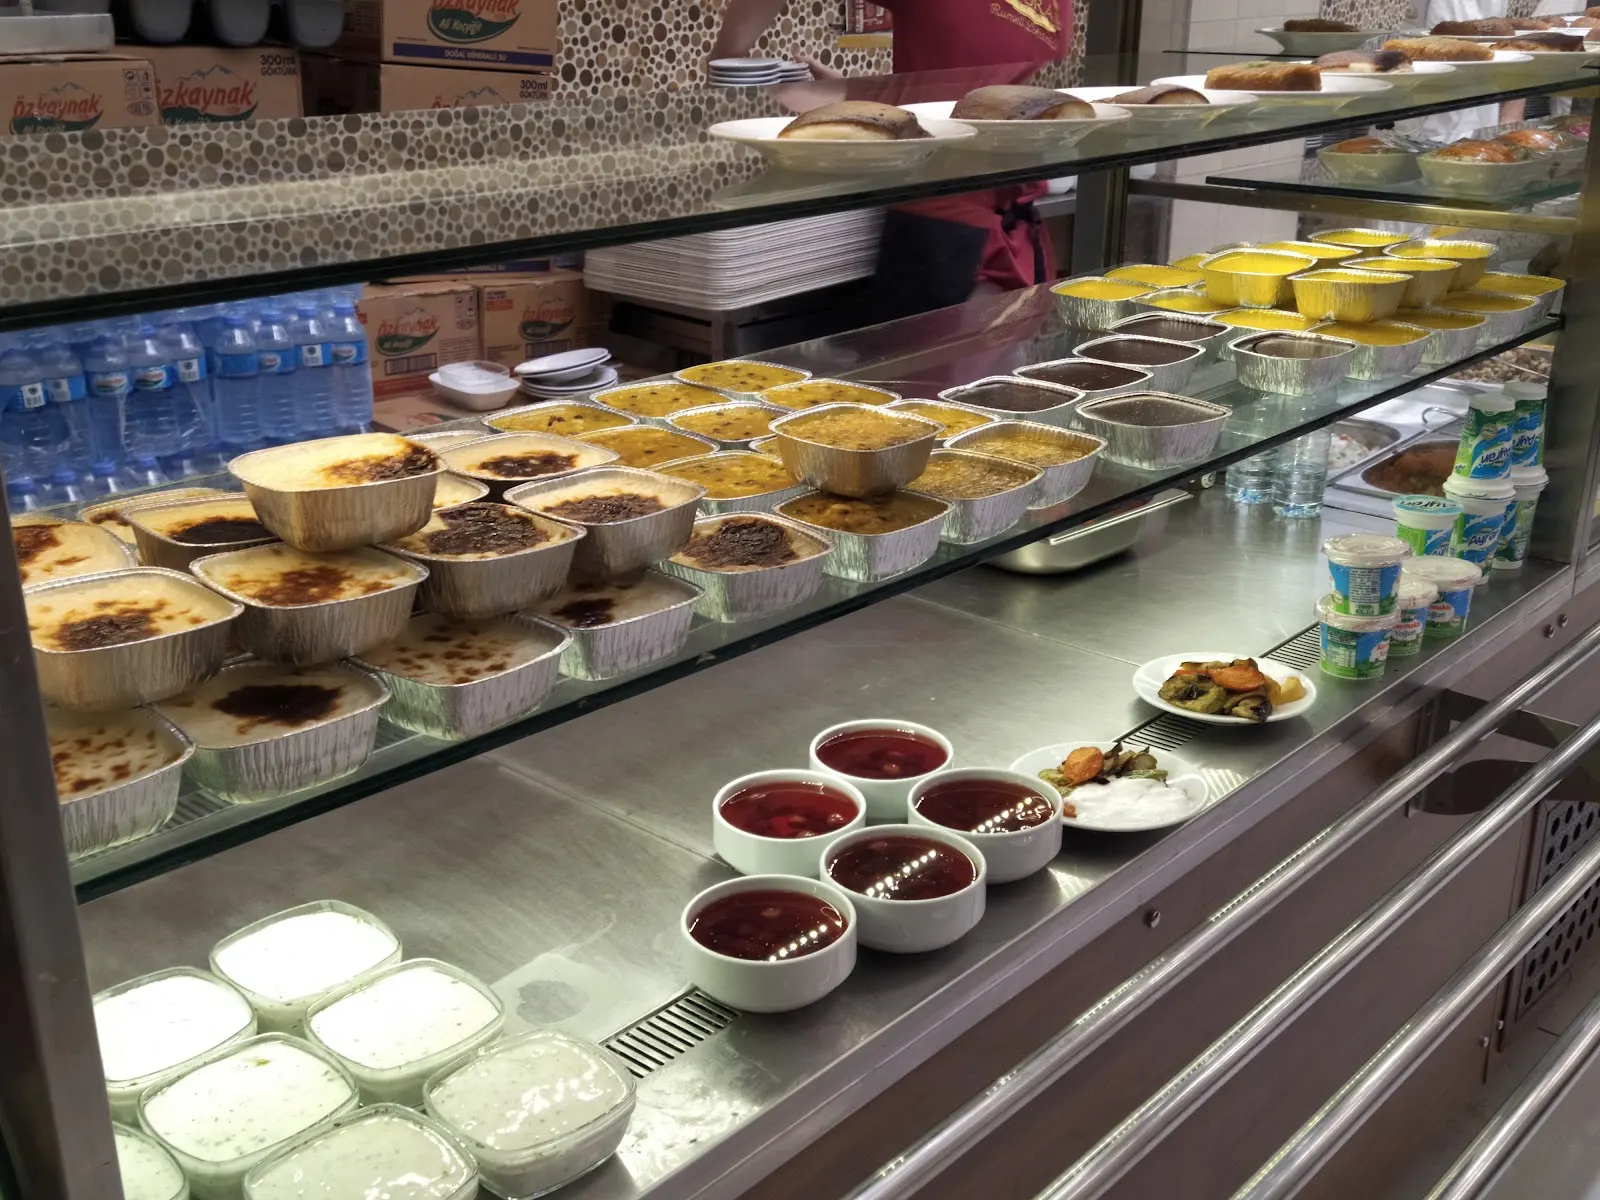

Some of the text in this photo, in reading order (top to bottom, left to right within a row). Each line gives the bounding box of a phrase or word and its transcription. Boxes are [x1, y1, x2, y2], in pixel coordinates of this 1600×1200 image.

[260, 54, 296, 66] 300ml
[520, 79, 548, 90] 300ml
[519, 90, 548, 100] GÖKTÜRK
[13, 94, 101, 120] Özkaynak
